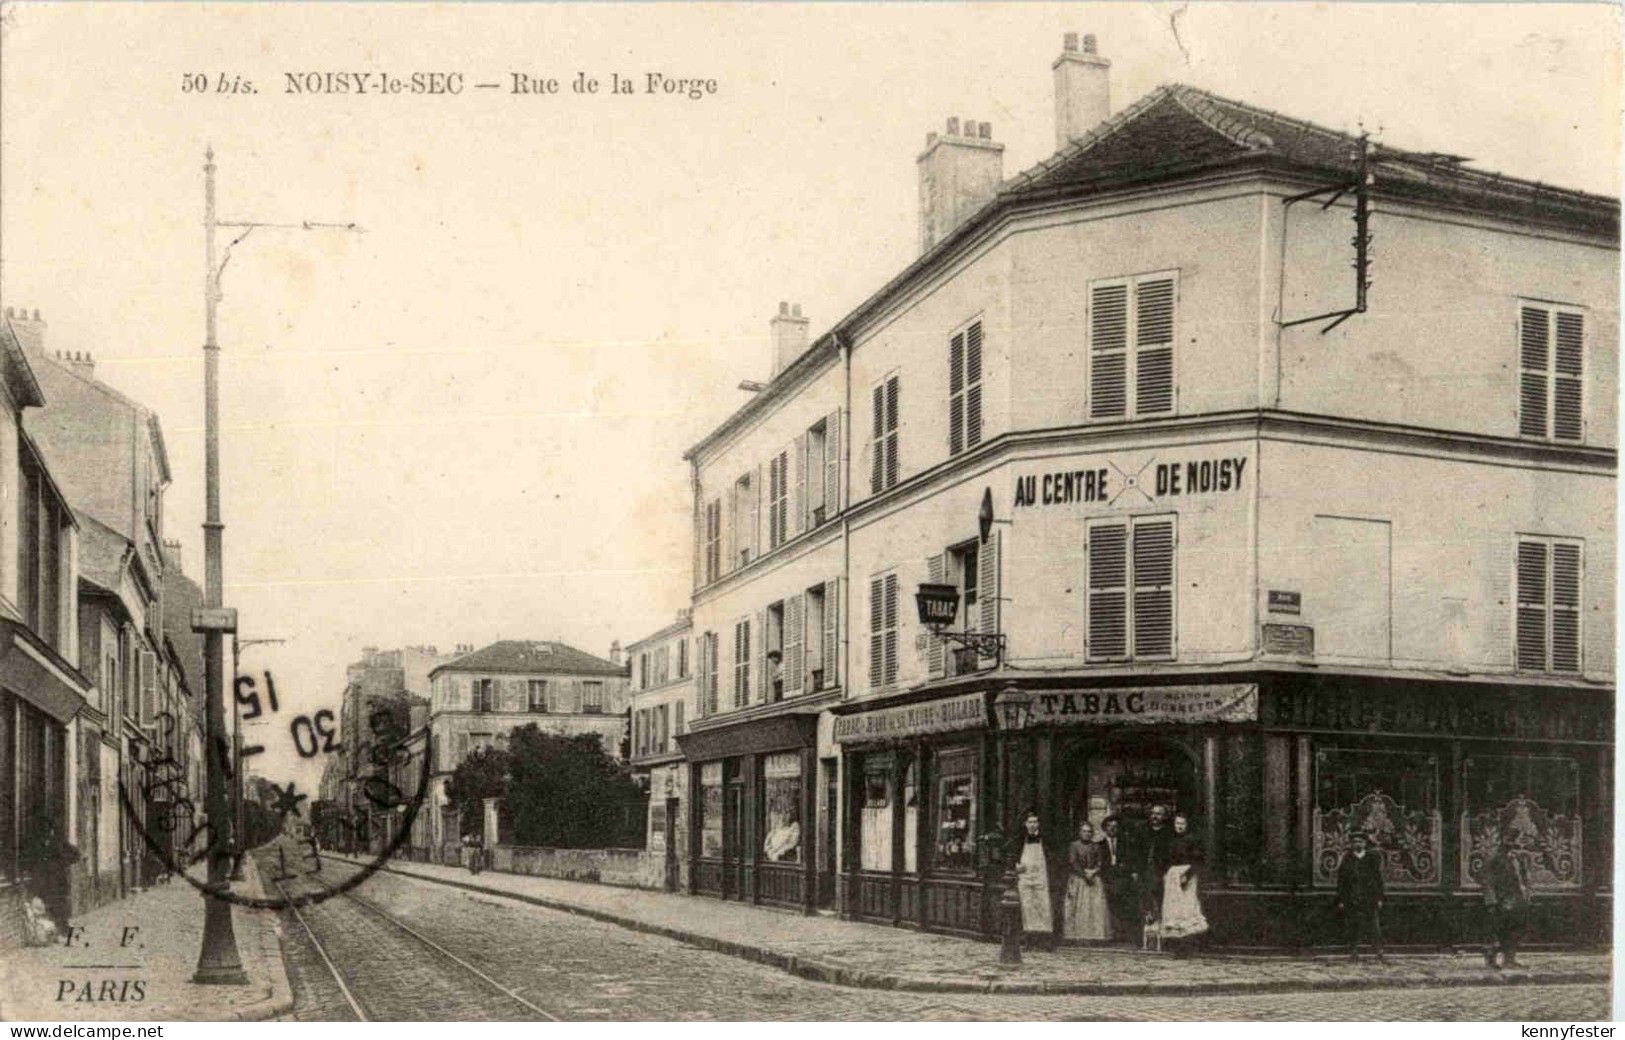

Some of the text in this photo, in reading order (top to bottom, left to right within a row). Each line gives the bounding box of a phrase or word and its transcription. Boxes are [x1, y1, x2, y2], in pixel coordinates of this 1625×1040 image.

[1014, 456, 1248, 507] AU CENTRE DE NOISY
[925, 600, 955, 617] TABAC
[1040, 692, 1144, 715] TABAC
